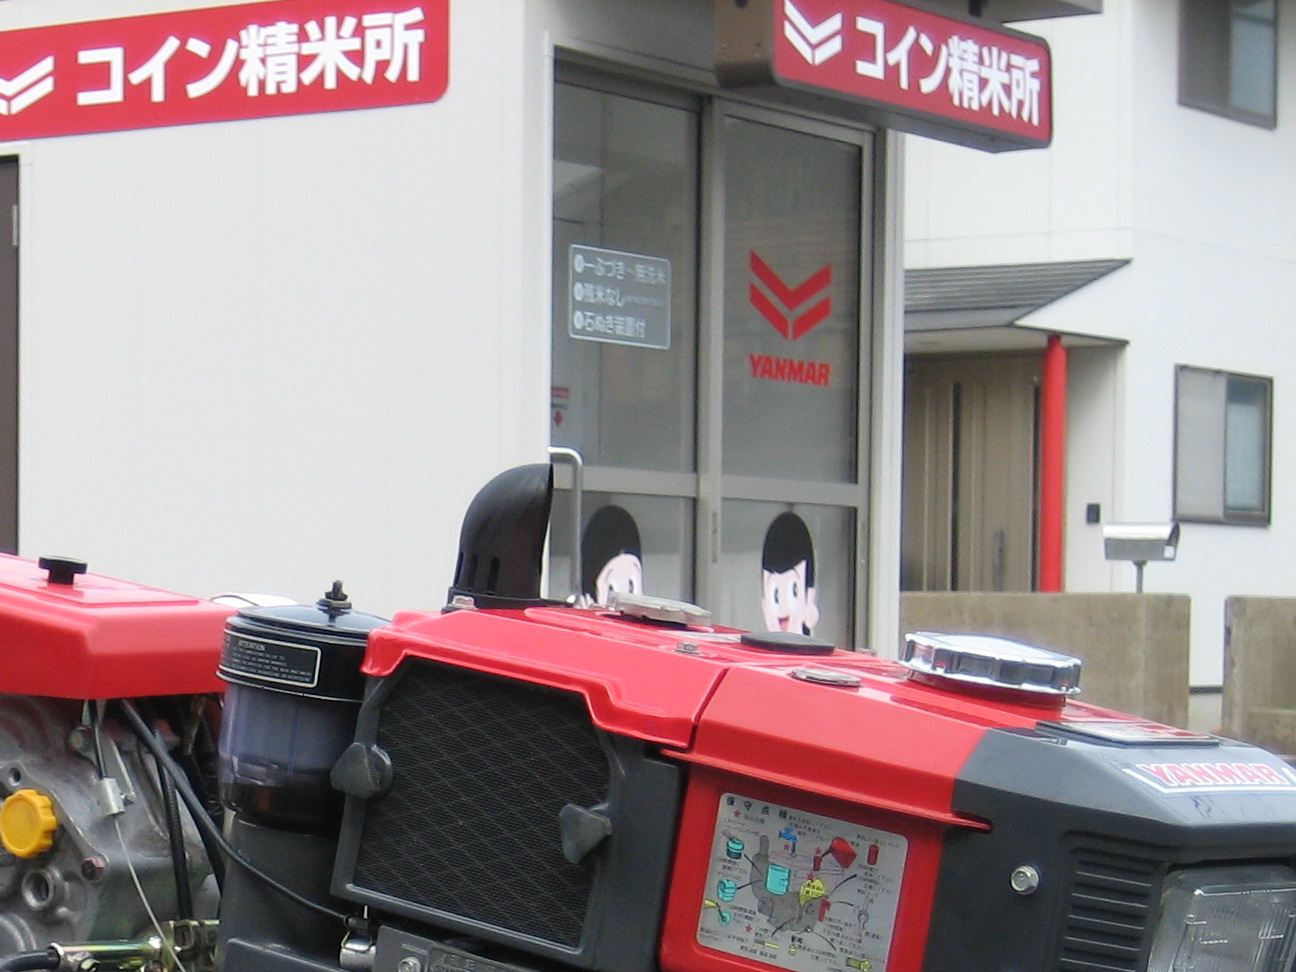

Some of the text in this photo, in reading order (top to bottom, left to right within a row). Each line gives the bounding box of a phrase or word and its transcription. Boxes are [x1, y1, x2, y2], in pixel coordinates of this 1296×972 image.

[76, 7, 426, 106] コイン精米所
[855, 16, 1040, 126] コイン精米所
[750, 354, 831, 386] YANMAR
[1136, 763, 1288, 786] YANMAR
